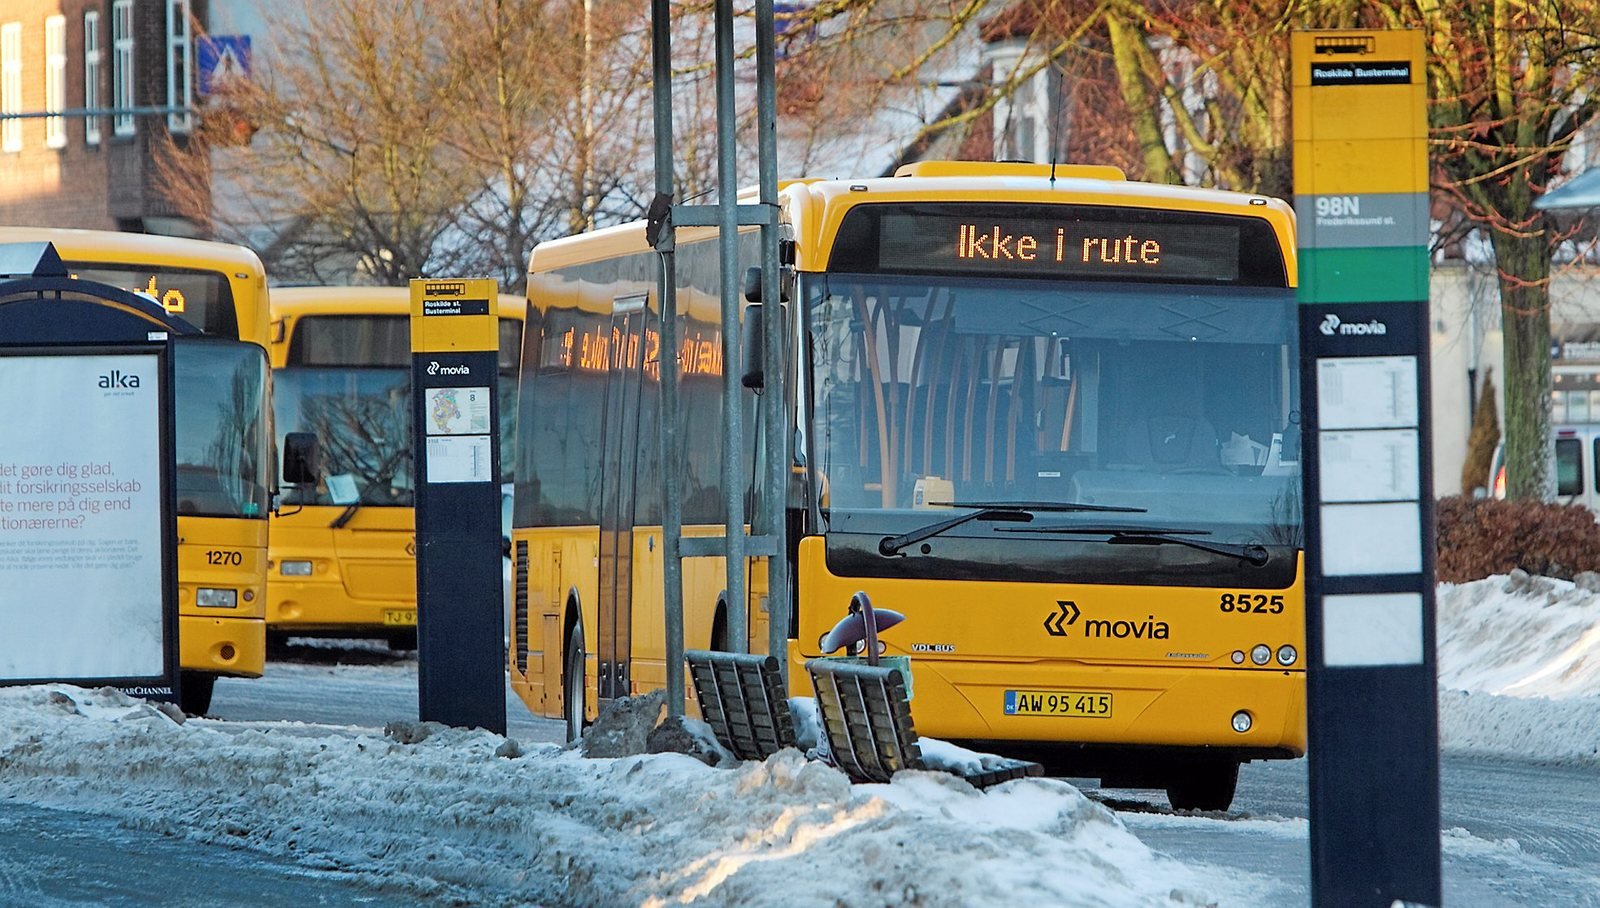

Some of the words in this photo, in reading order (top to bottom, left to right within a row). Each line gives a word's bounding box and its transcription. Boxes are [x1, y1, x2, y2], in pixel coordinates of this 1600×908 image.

[1313, 68, 1353, 78] Roskilde
[1355, 67, 1409, 77] Busterminal
[1316, 196, 1360, 216] 98N
[959, 224, 1038, 260] Ikke
[1056, 228, 1065, 262] i
[1082, 235, 1161, 264] rute
[1340, 319, 1387, 335] movia
[440, 364, 470, 375] movia
[21, 465, 53, 480] gøre
[56, 463, 77, 479] dig
[81, 461, 115, 478] glad,
[16, 478, 142, 496] forsikringsselskab
[18, 500, 54, 511] mere
[58, 498, 75, 513] på
[79, 498, 101, 513] dig
[104, 497, 131, 510] end
[205, 550, 242, 566] 1270
[1220, 593, 1285, 614] 8525
[1084, 615, 1170, 639] movia
[911, 643, 932, 652] VDL
[935, 644, 955, 652] BUS
[1018, 694, 1043, 712] AW
[1048, 695, 1070, 713] 95
[1075, 696, 1109, 714] 415
